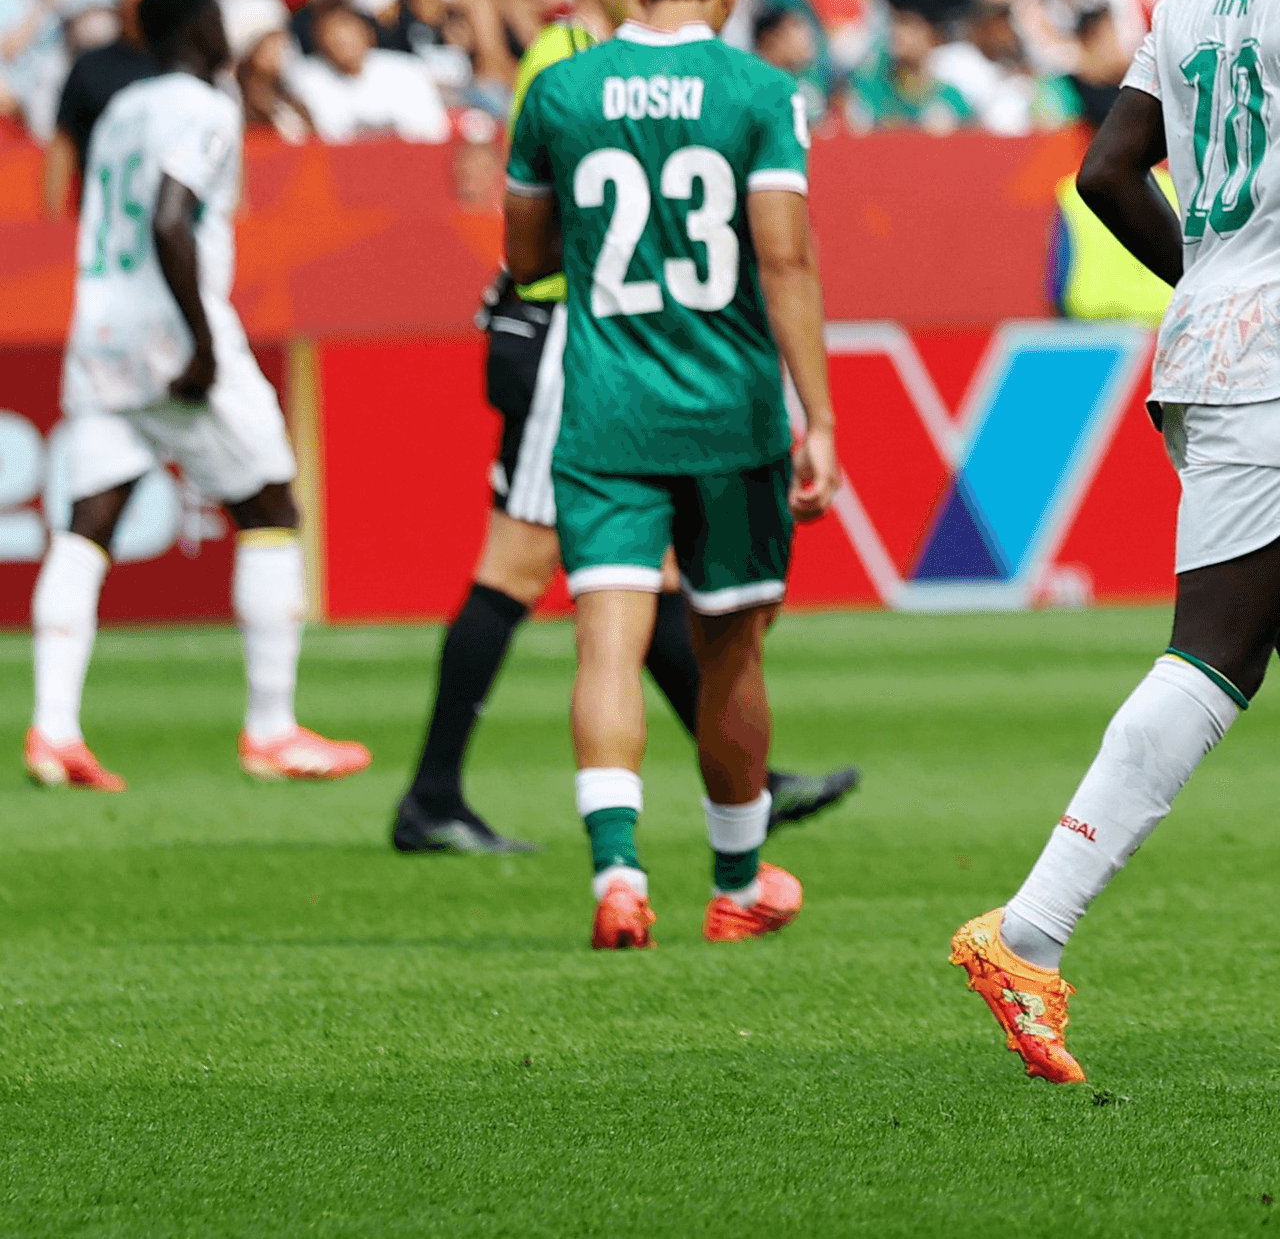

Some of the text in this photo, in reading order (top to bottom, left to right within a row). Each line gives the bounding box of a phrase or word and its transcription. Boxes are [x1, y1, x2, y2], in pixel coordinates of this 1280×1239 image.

[602, 75, 704, 121] DOSKI
[1180, 38, 1268, 244] 10
[84, 150, 152, 279] 15
[573, 145, 740, 319] 23
[1058, 814, 1097, 843] EGAL
